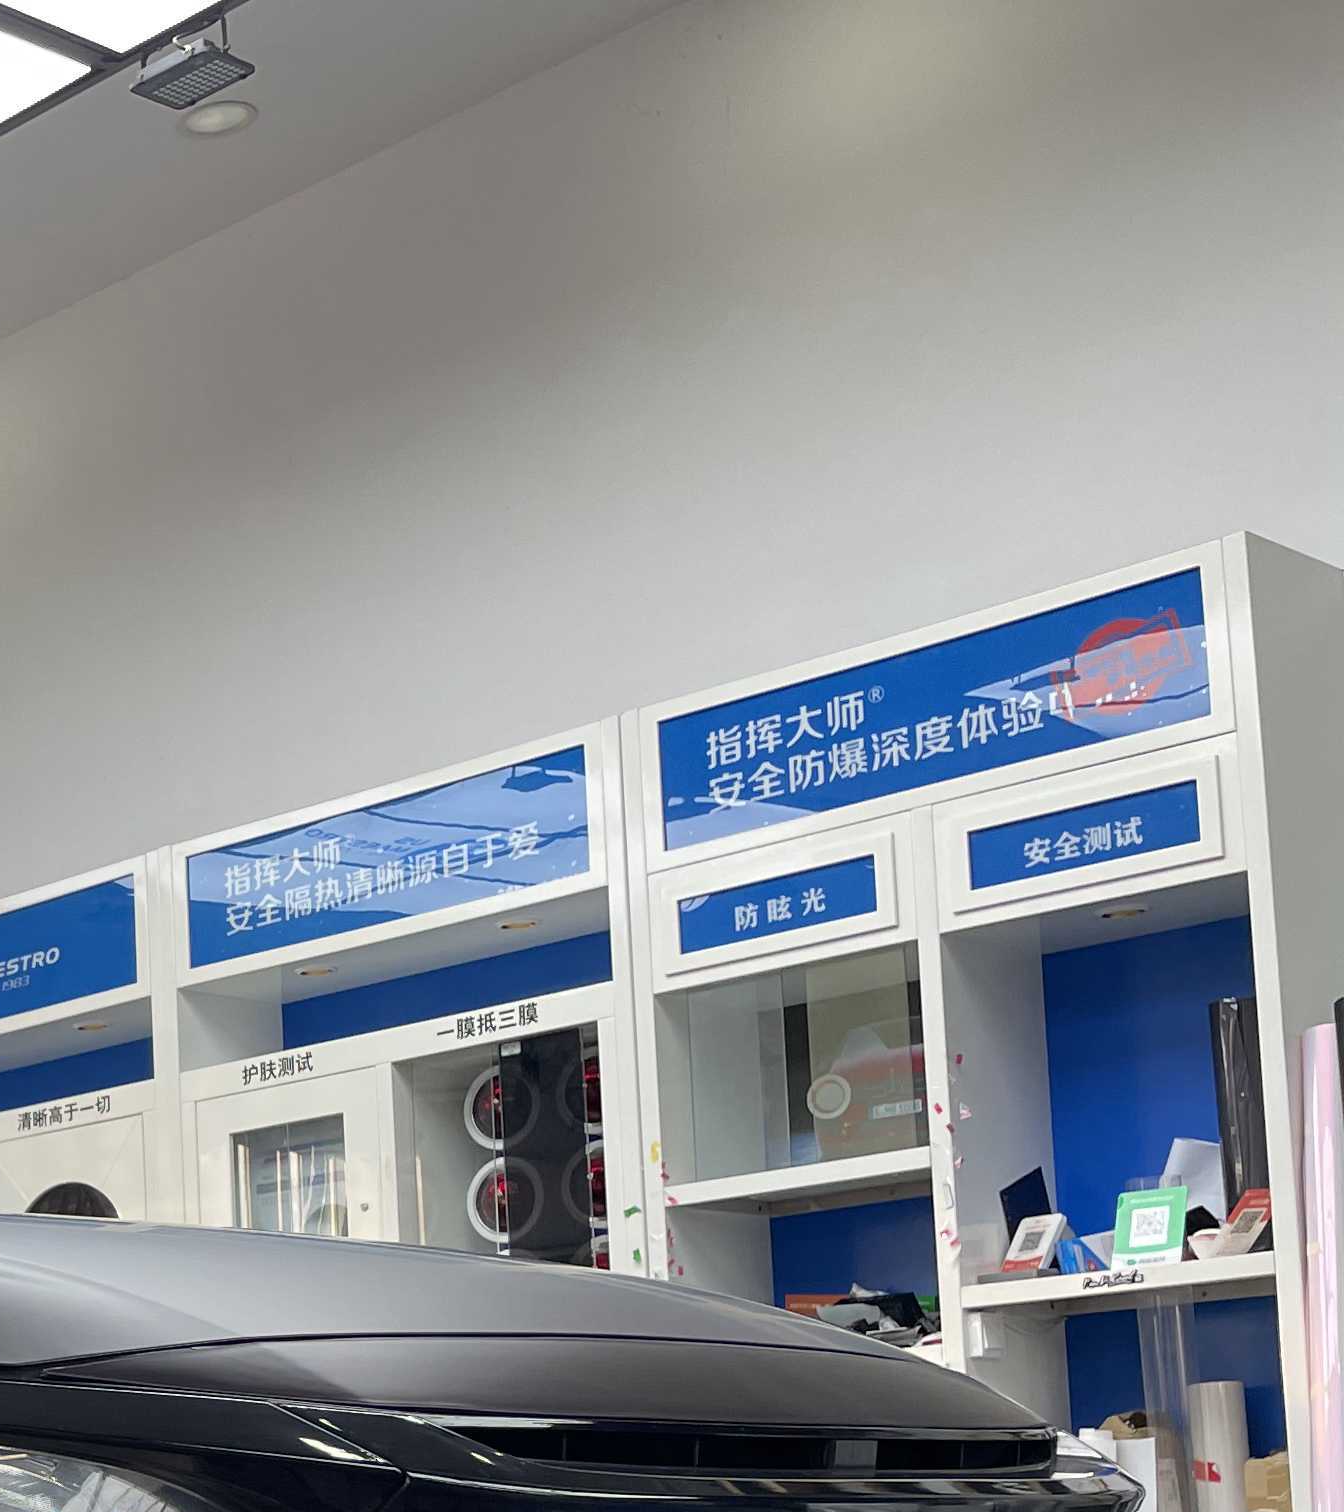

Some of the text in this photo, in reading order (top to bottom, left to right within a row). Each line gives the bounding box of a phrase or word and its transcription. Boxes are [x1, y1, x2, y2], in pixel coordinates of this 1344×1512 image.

[1023, 816, 1144, 868] 安全测试
[226, 821, 540, 937] 安全隔热清晰源自于爱
[734, 888, 826, 931] 防眩光
[436, 1002, 539, 1041] 一膜抵三膜
[242, 1051, 314, 1086] 护肤测试
[17, 1095, 112, 1131] 清晰高于一切
